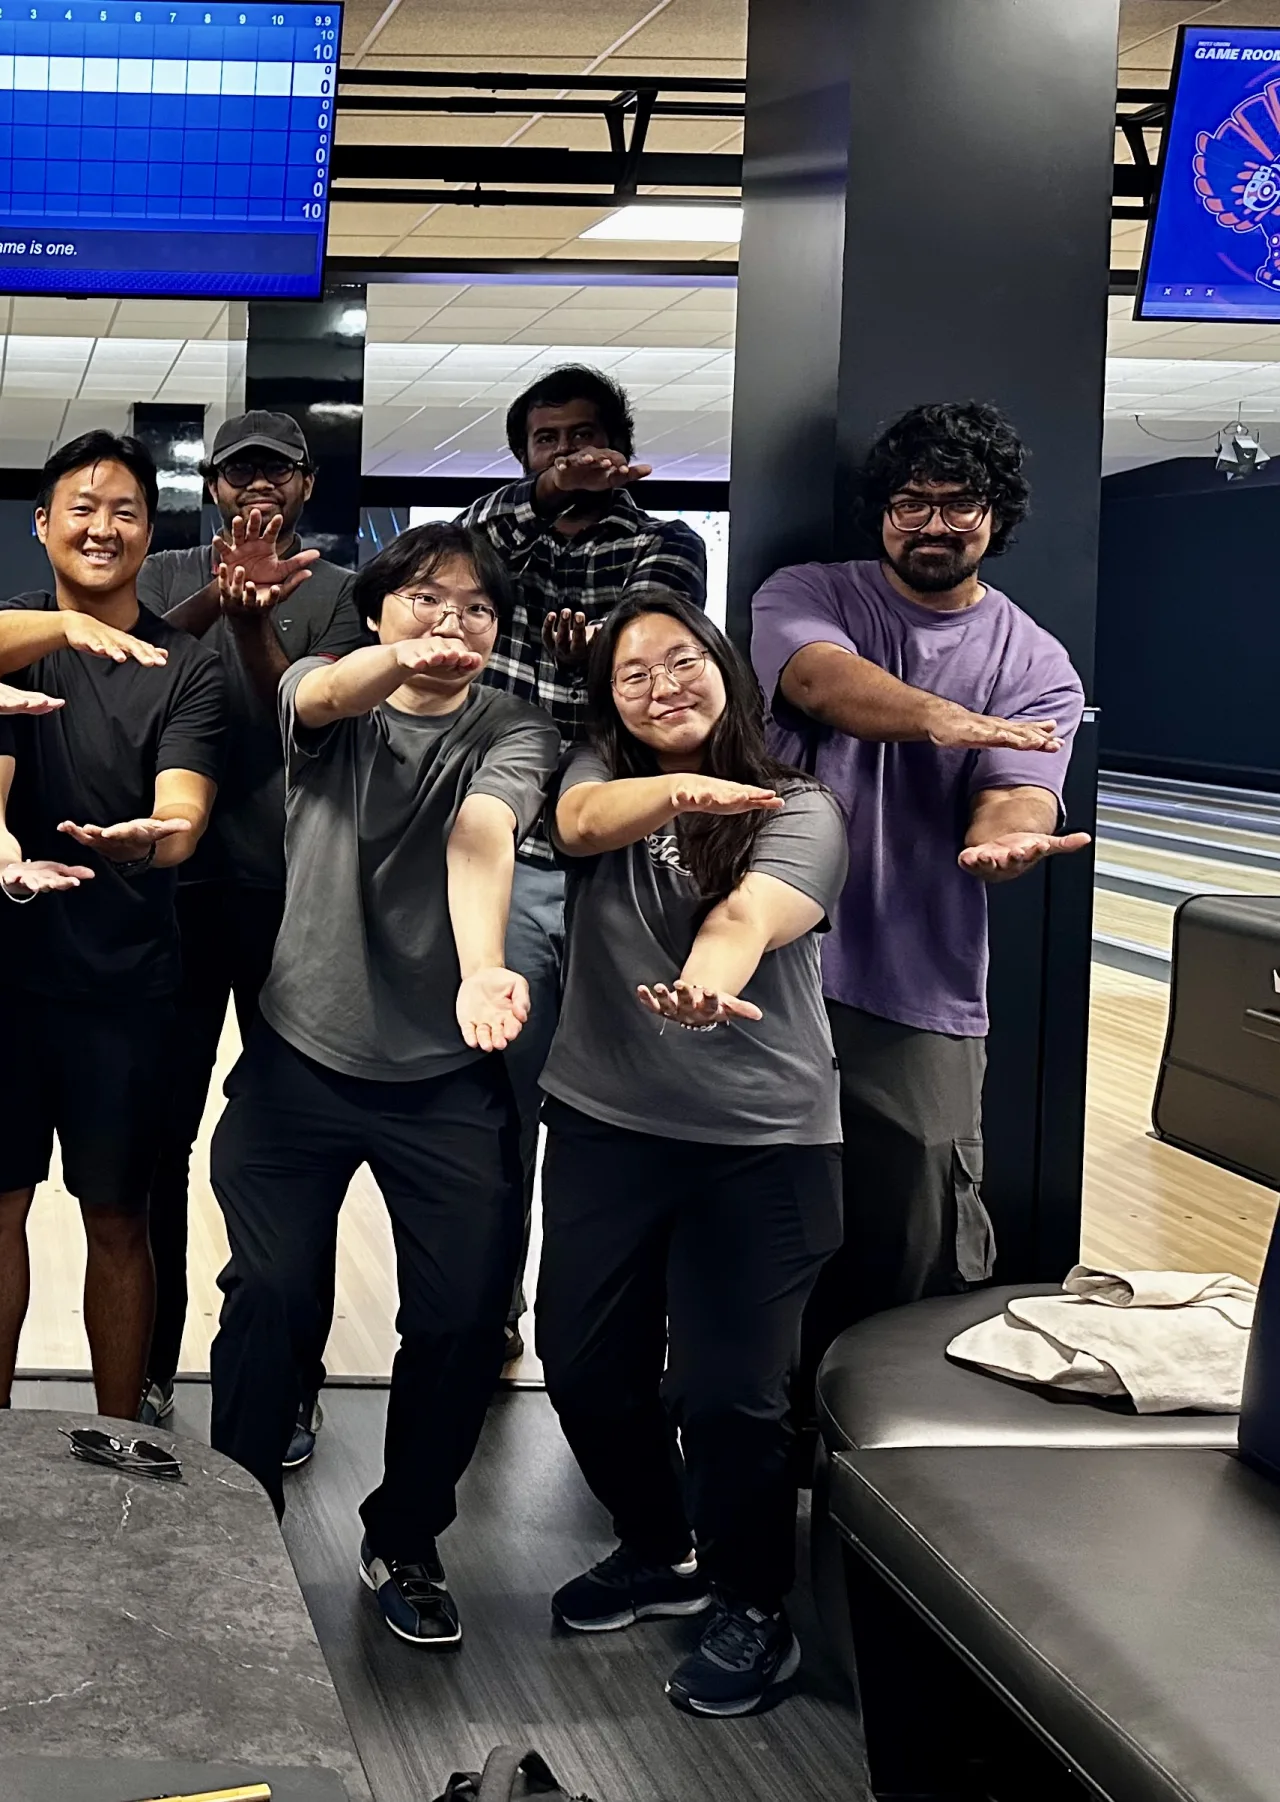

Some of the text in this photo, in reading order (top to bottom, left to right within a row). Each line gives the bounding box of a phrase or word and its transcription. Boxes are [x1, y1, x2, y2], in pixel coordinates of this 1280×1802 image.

[30, 9, 37, 19] 3
[65, 10, 72, 20] 4
[100, 11, 107, 21] 5
[135, 12, 142, 22] 6
[170, 12, 177, 23] 7
[204, 13, 211, 24] 8
[239, 14, 246, 24] 9
[272, 15, 284, 25] 10
[315, 16, 331, 26] 9.9
[321, 30, 334, 40] 10
[313, 44, 333, 60] 10
[1194, 48, 1240, 60] GAME
[324, 65, 332, 75] 0
[321, 79, 330, 94] 0
[322, 100, 330, 110] 0
[318, 114, 328, 129] 0
[320, 134, 327, 144] 0
[316, 148, 326, 163] 0
[317, 168, 325, 178] 0
[313, 182, 323, 197] 0
[302, 203, 321, 218] 10
[29, 240, 42, 254] is
[46, 244, 77, 255] one.
